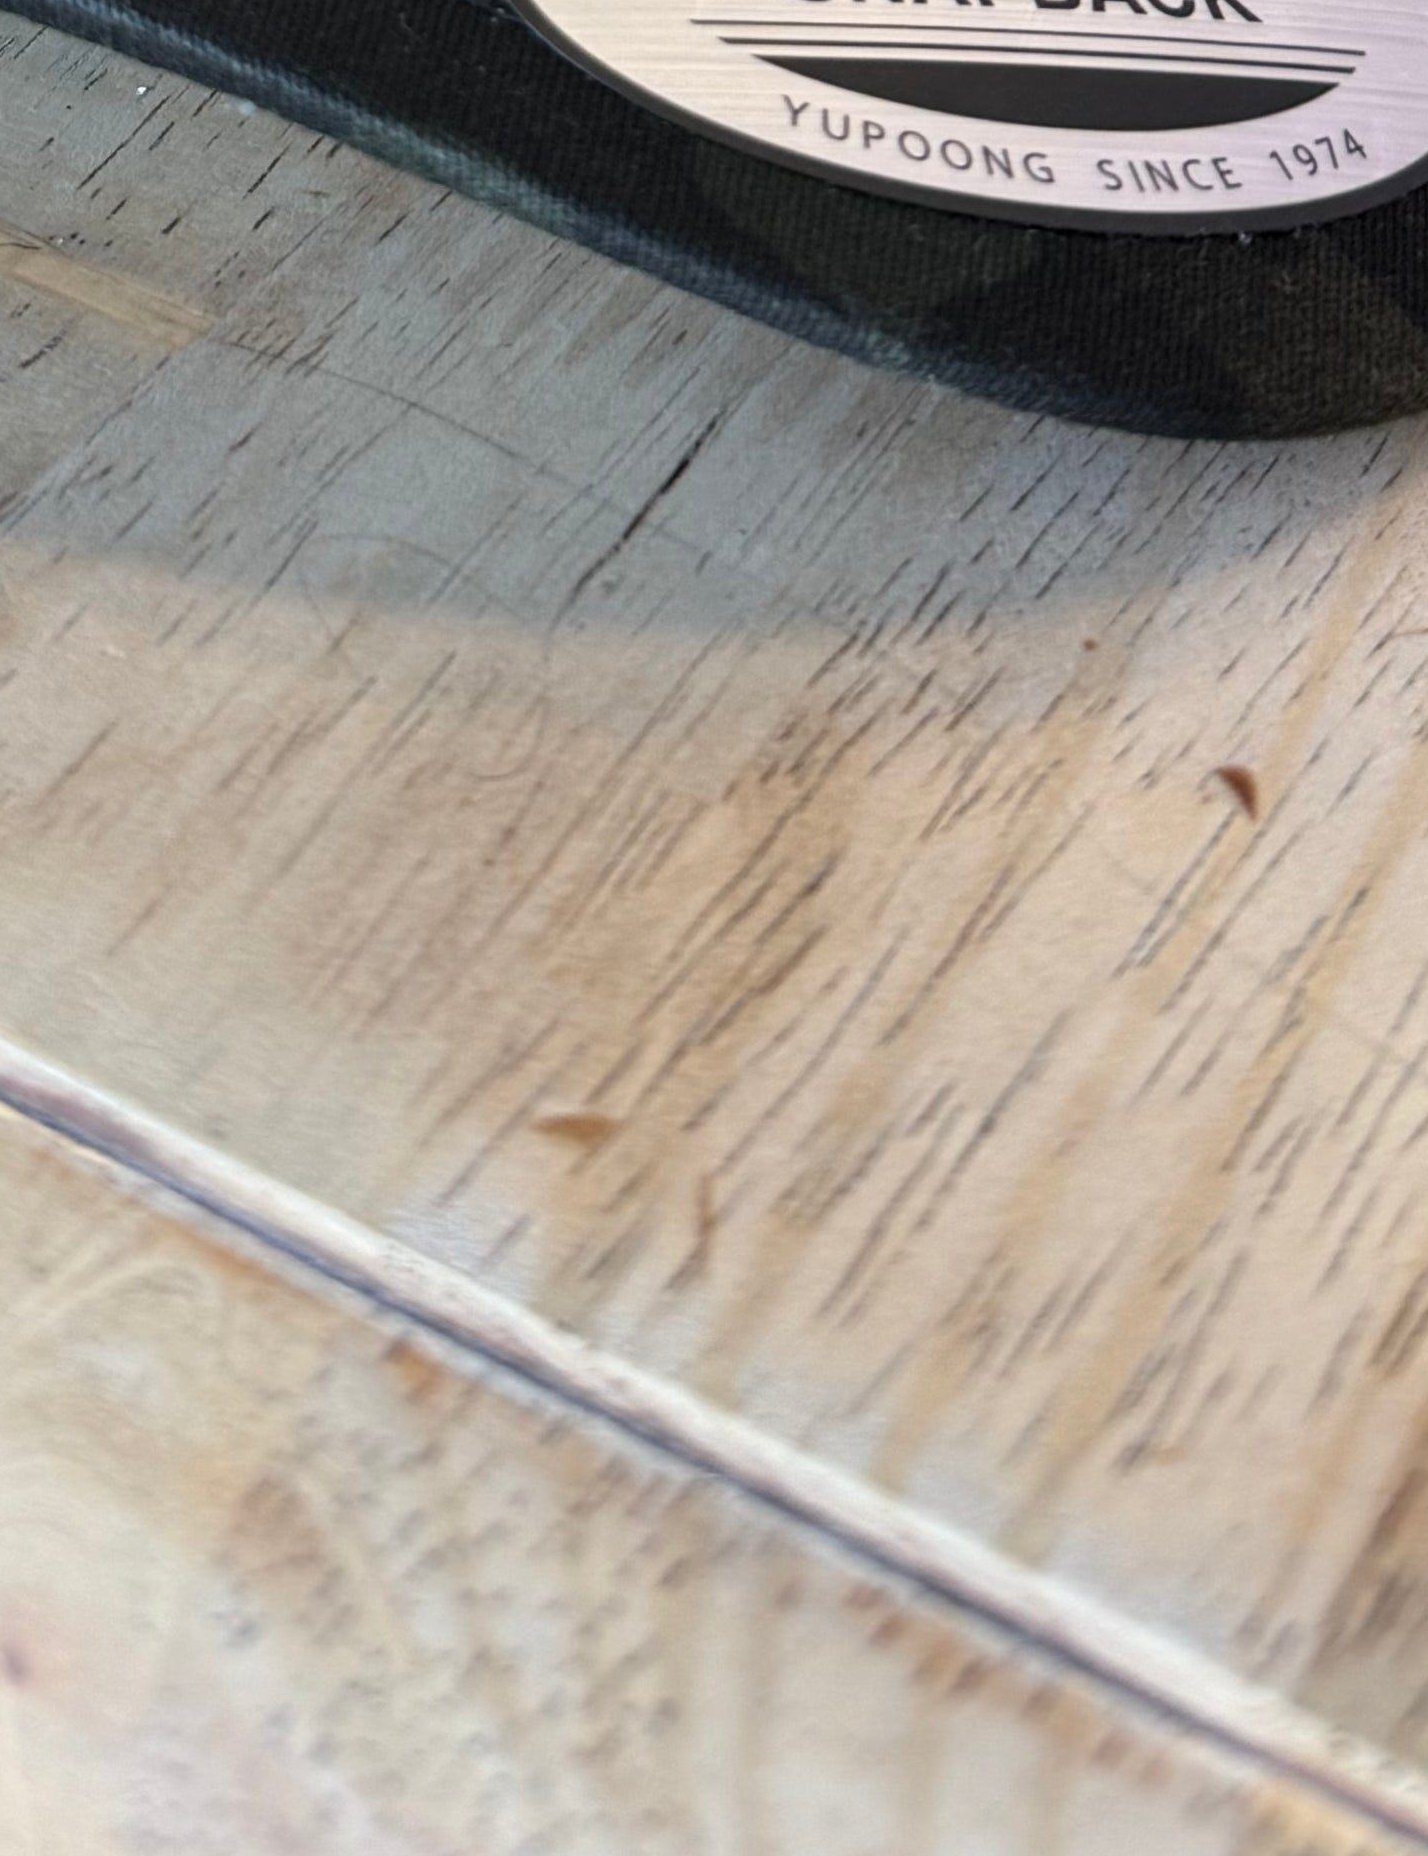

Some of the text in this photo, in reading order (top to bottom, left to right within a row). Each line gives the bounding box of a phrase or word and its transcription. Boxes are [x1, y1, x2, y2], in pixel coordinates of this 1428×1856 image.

[780, 93, 1369, 194] YUPOONG SINCE 1974
